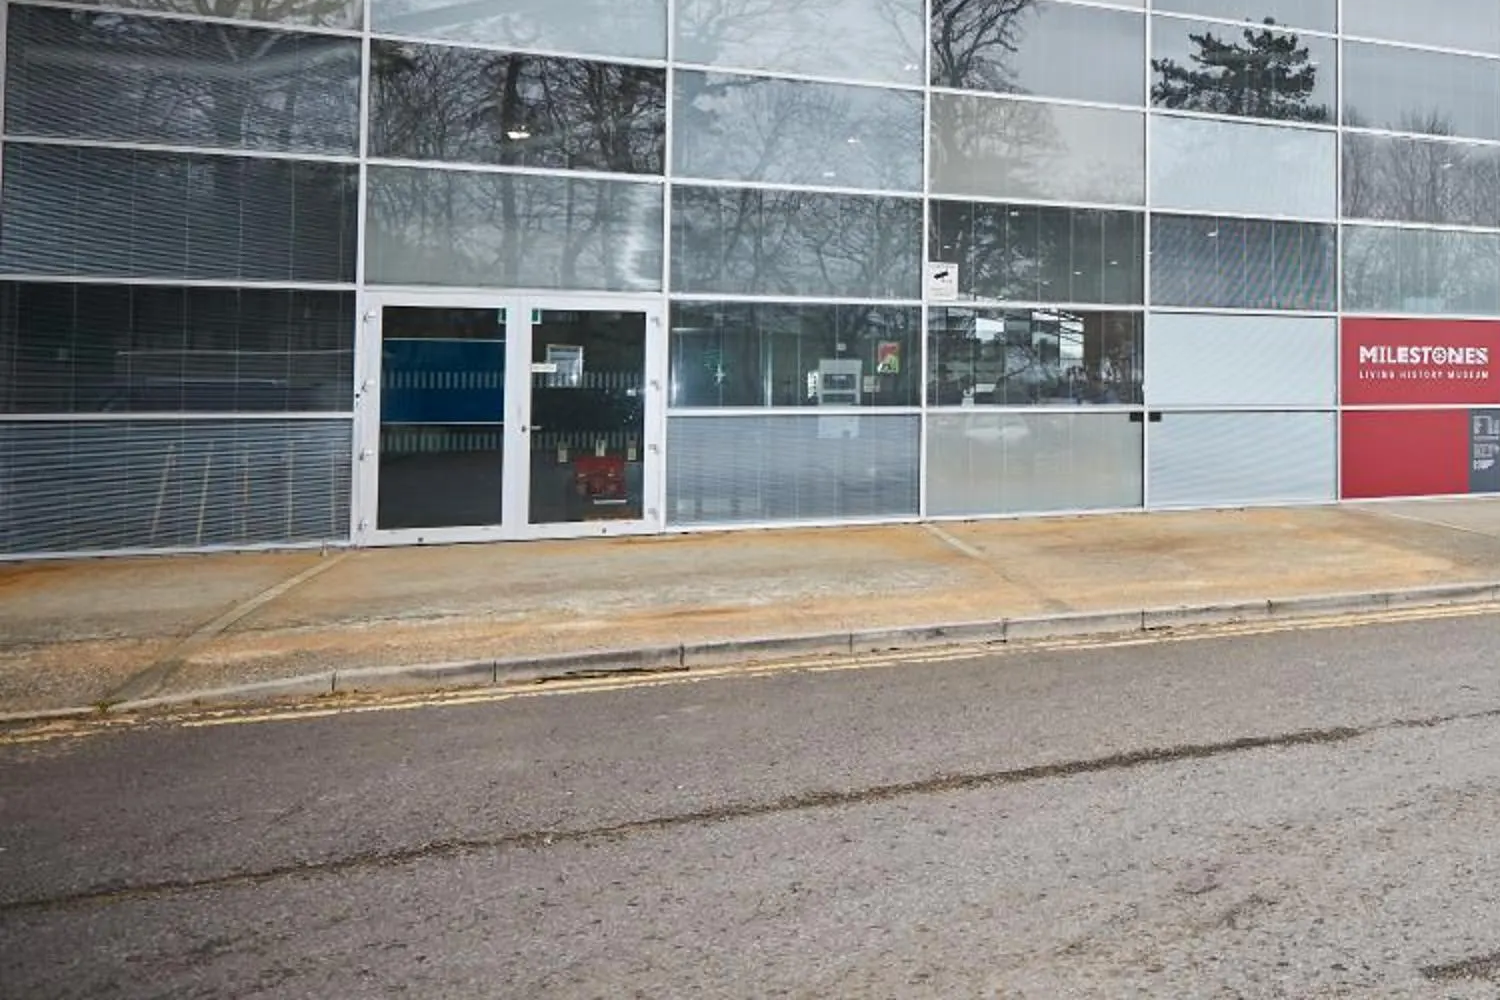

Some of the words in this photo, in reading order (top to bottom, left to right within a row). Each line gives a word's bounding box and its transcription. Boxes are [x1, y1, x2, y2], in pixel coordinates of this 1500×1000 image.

[1359, 345, 1489, 364] MILESTONES
[1359, 369, 1395, 379] LIVING
[1400, 369, 1443, 379] HISTORY
[1447, 369, 1489, 379] MUSEUM
